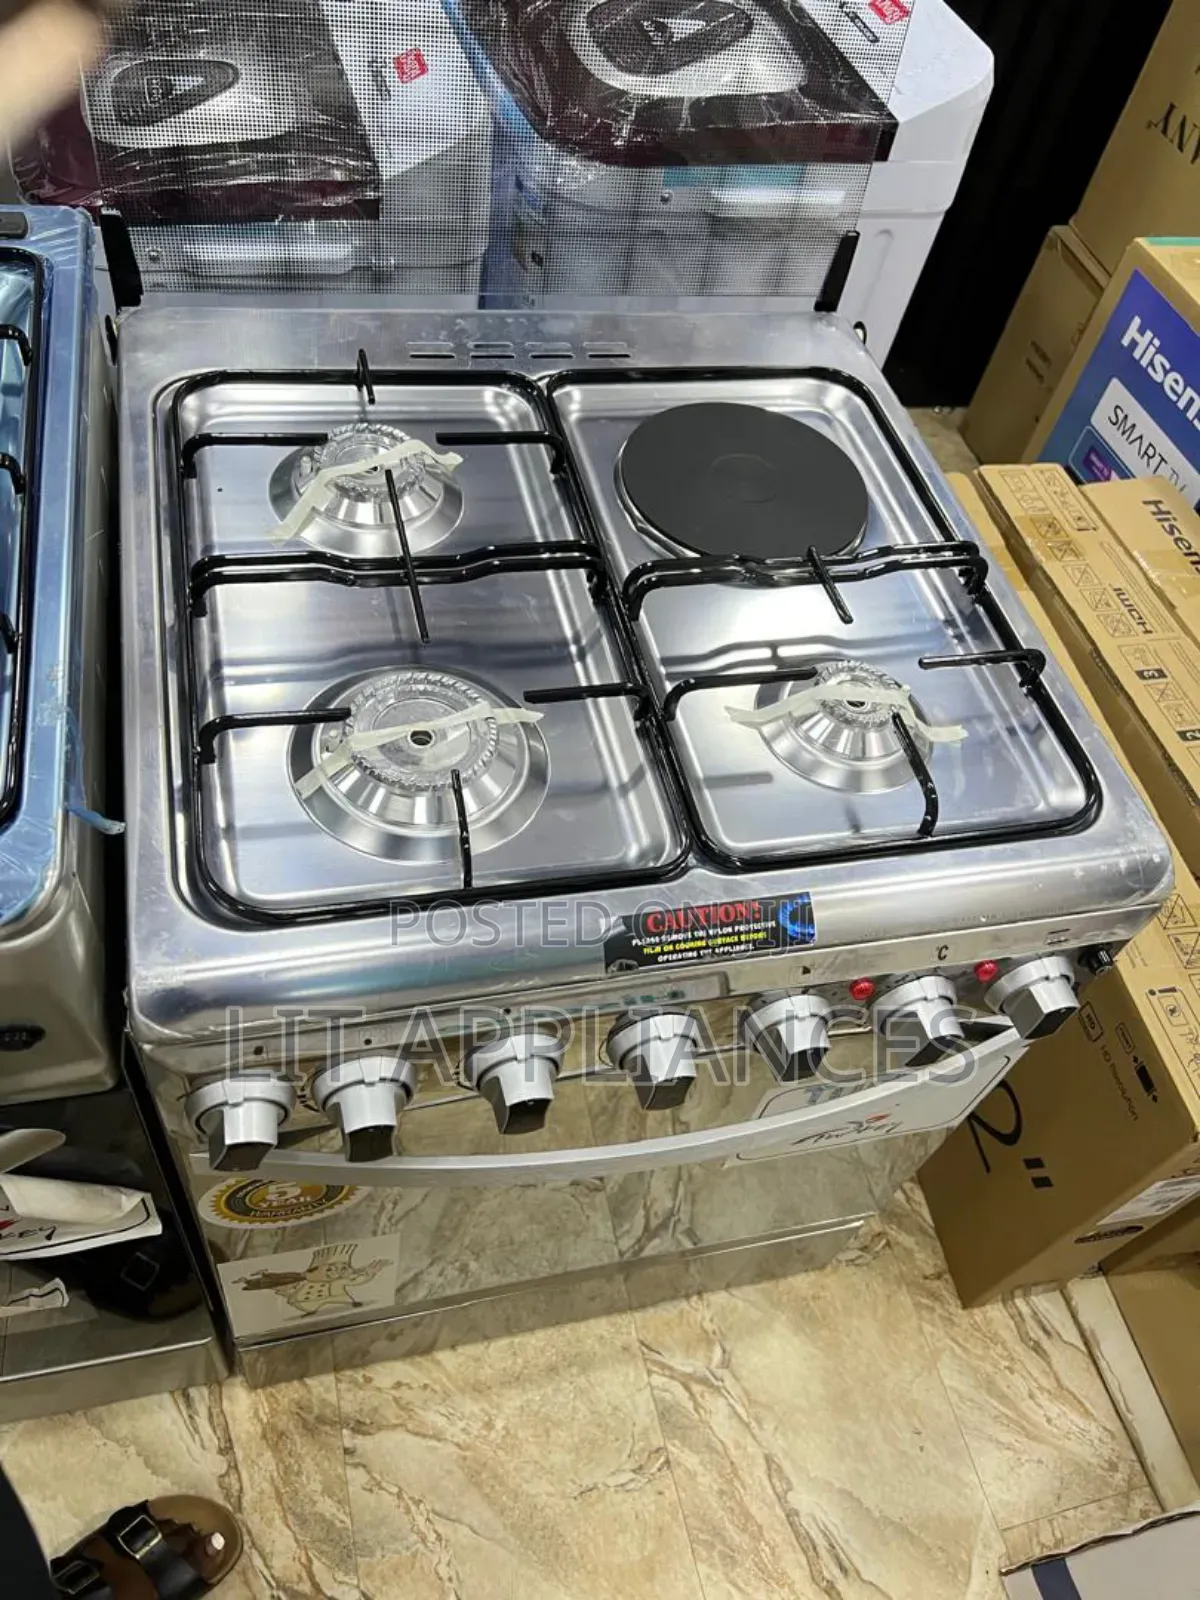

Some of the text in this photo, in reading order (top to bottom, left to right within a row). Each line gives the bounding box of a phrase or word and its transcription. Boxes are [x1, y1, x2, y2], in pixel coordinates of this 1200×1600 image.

[1121, 315, 1200, 431] Hisen
[1108, 405, 1168, 476] SMART
[1142, 499, 1200, 575] Hisen
[1113, 587, 1153, 635] HDMI
[646, 900, 760, 933] CAUTION!
